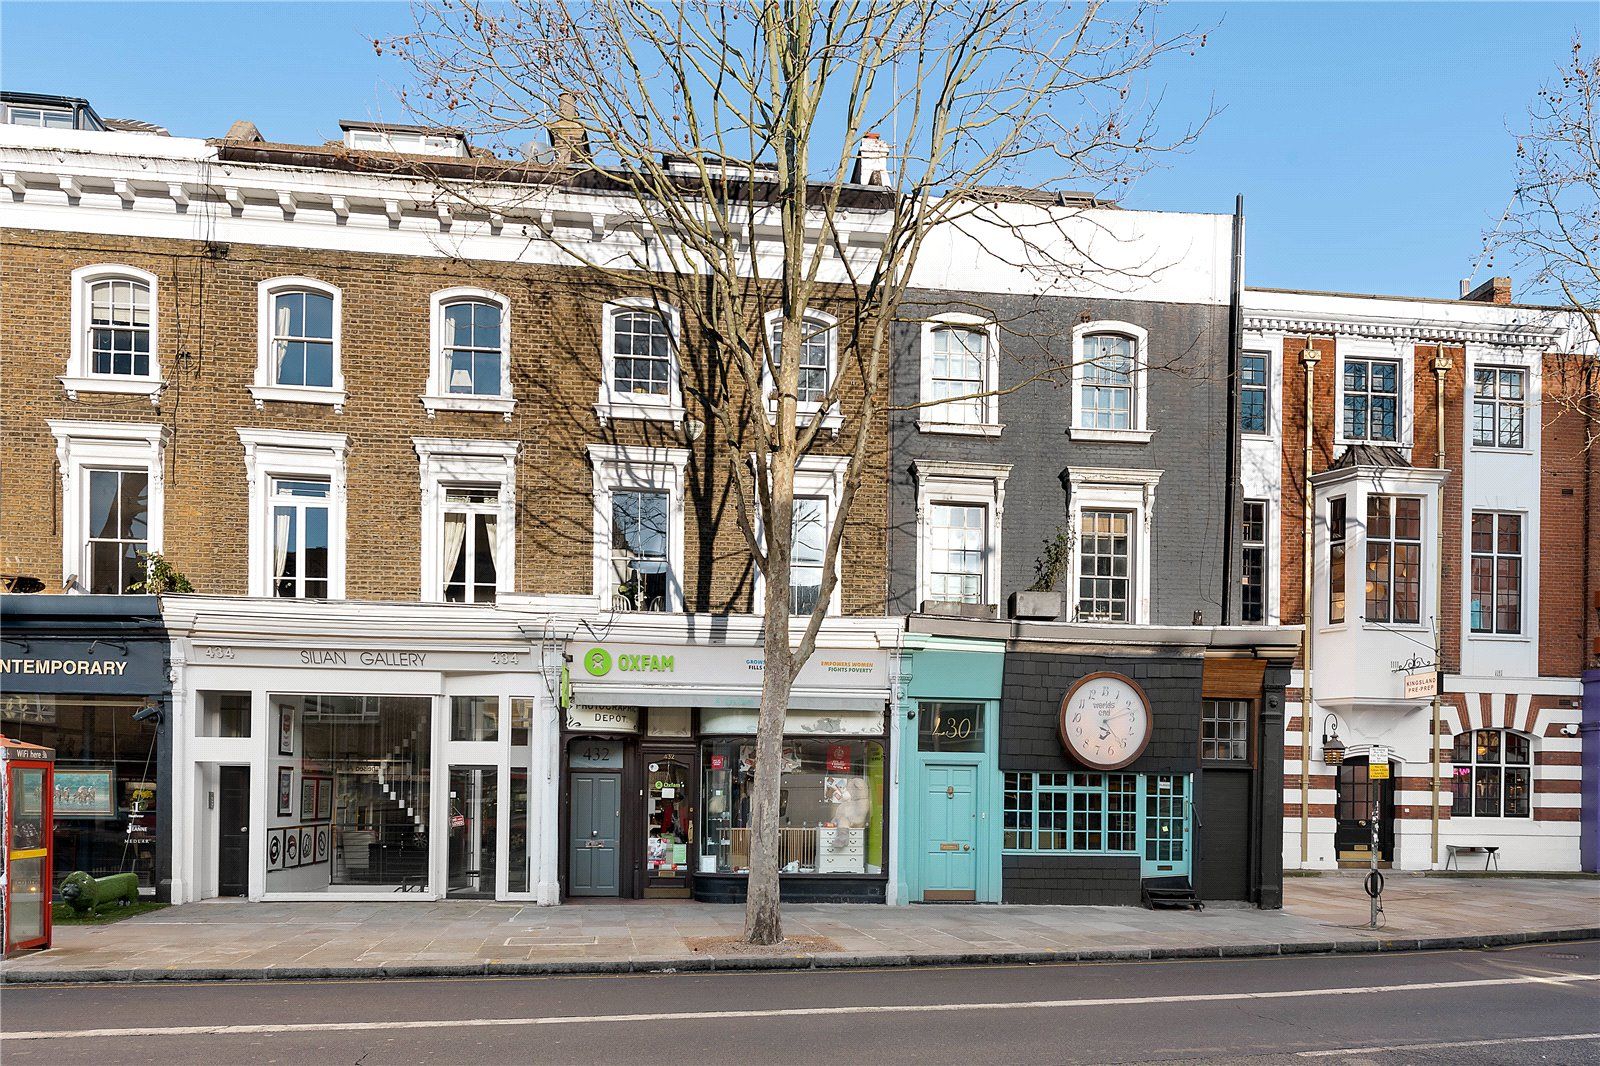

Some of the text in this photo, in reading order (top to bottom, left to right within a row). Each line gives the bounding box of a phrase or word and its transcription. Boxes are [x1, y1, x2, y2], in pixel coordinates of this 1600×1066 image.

[205, 646, 235, 659] 434
[300, 650, 427, 666] SILIAN GALLERY
[490, 652, 519, 665] 434
[617, 653, 675, 673] OXFAM
[1406, 677, 1437, 686] KINGSLAND
[1408, 684, 1434, 693] PRE-PREP
[582, 747, 610, 761] 432
[1107, 745, 1114, 756] 6
